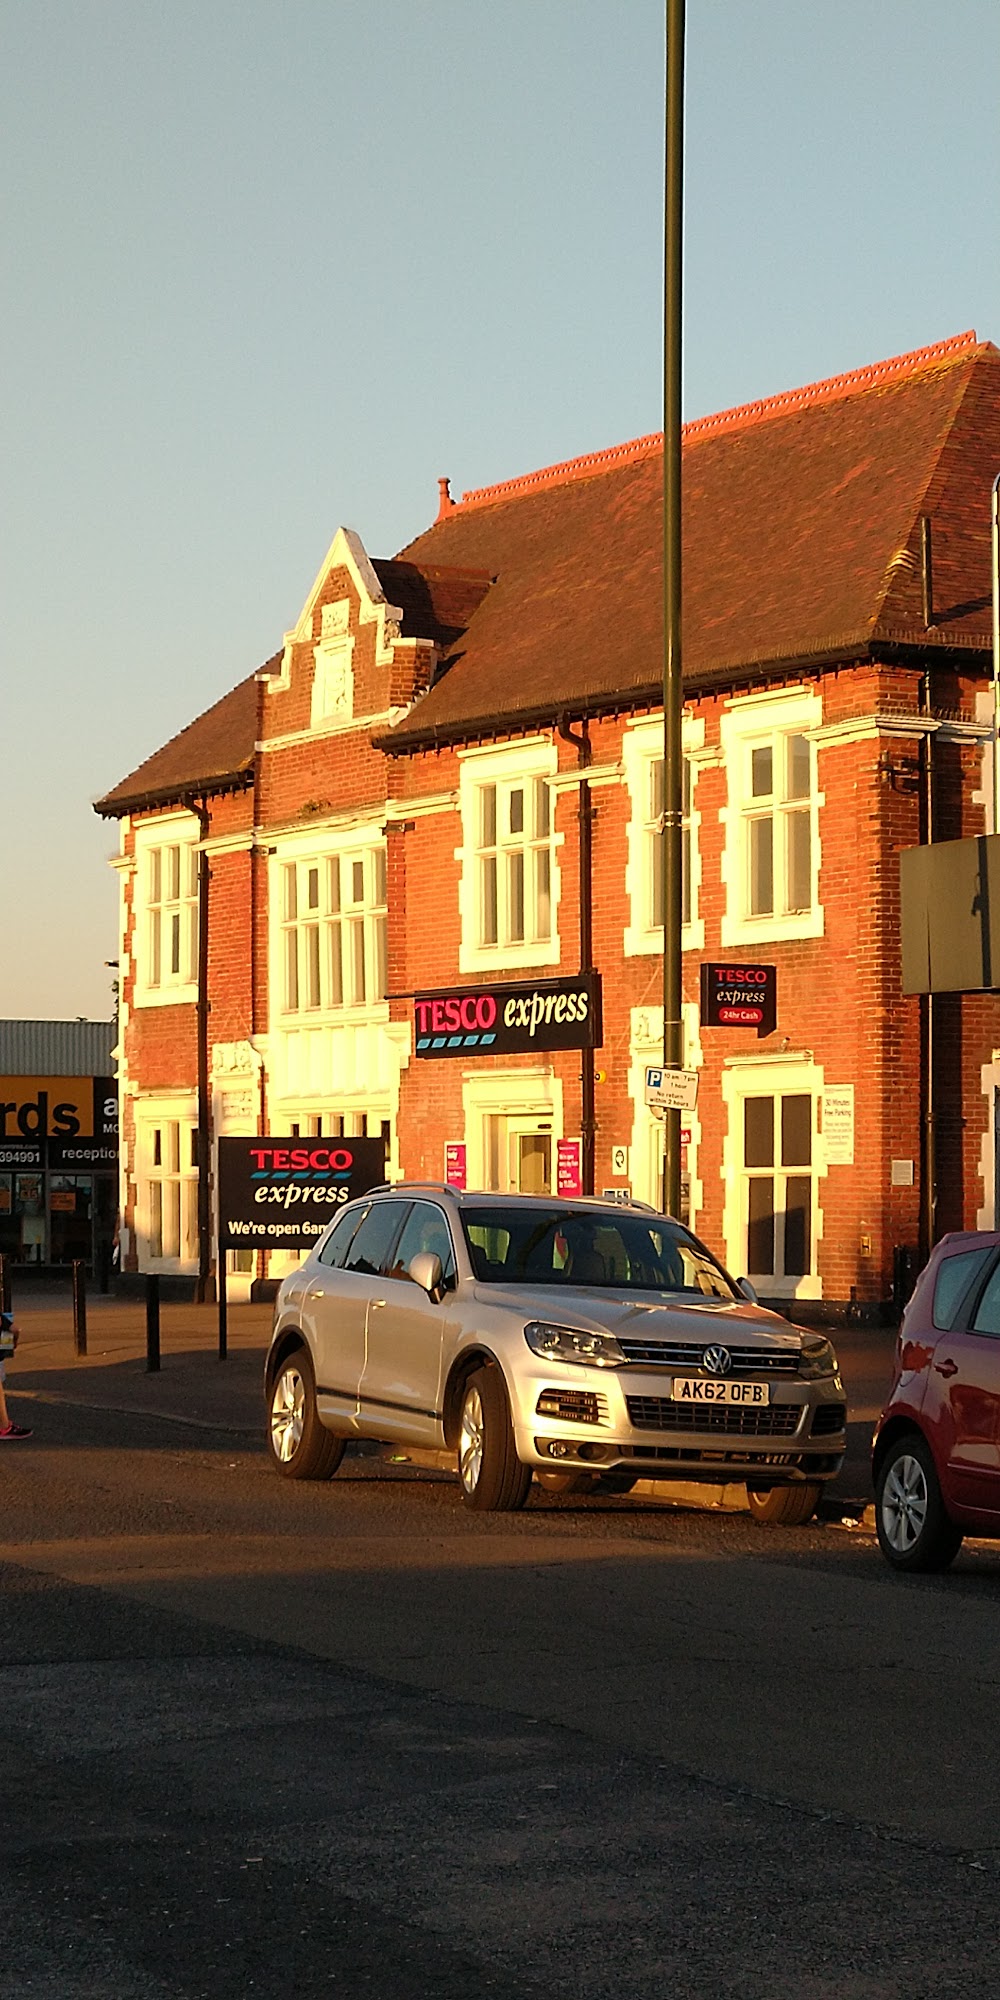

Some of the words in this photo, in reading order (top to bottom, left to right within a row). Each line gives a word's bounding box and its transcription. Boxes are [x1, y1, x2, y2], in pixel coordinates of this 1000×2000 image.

[714, 969, 767, 983] TESCO
[716, 990, 766, 1005] express
[414, 995, 496, 1032] TESCO
[503, 991, 588, 1036] express
[723, 1011, 740, 1019] 24hr
[740, 1011, 758, 1019] Cash
[62, 1147, 119, 1161] receptio
[250, 1149, 354, 1170] TESCO
[254, 1183, 350, 1209] express
[228, 1221, 265, 1235] We're
[267, 1224, 301, 1238] open
[681, 1381, 726, 1400] AK62
[731, 1384, 763, 1402] OFB
